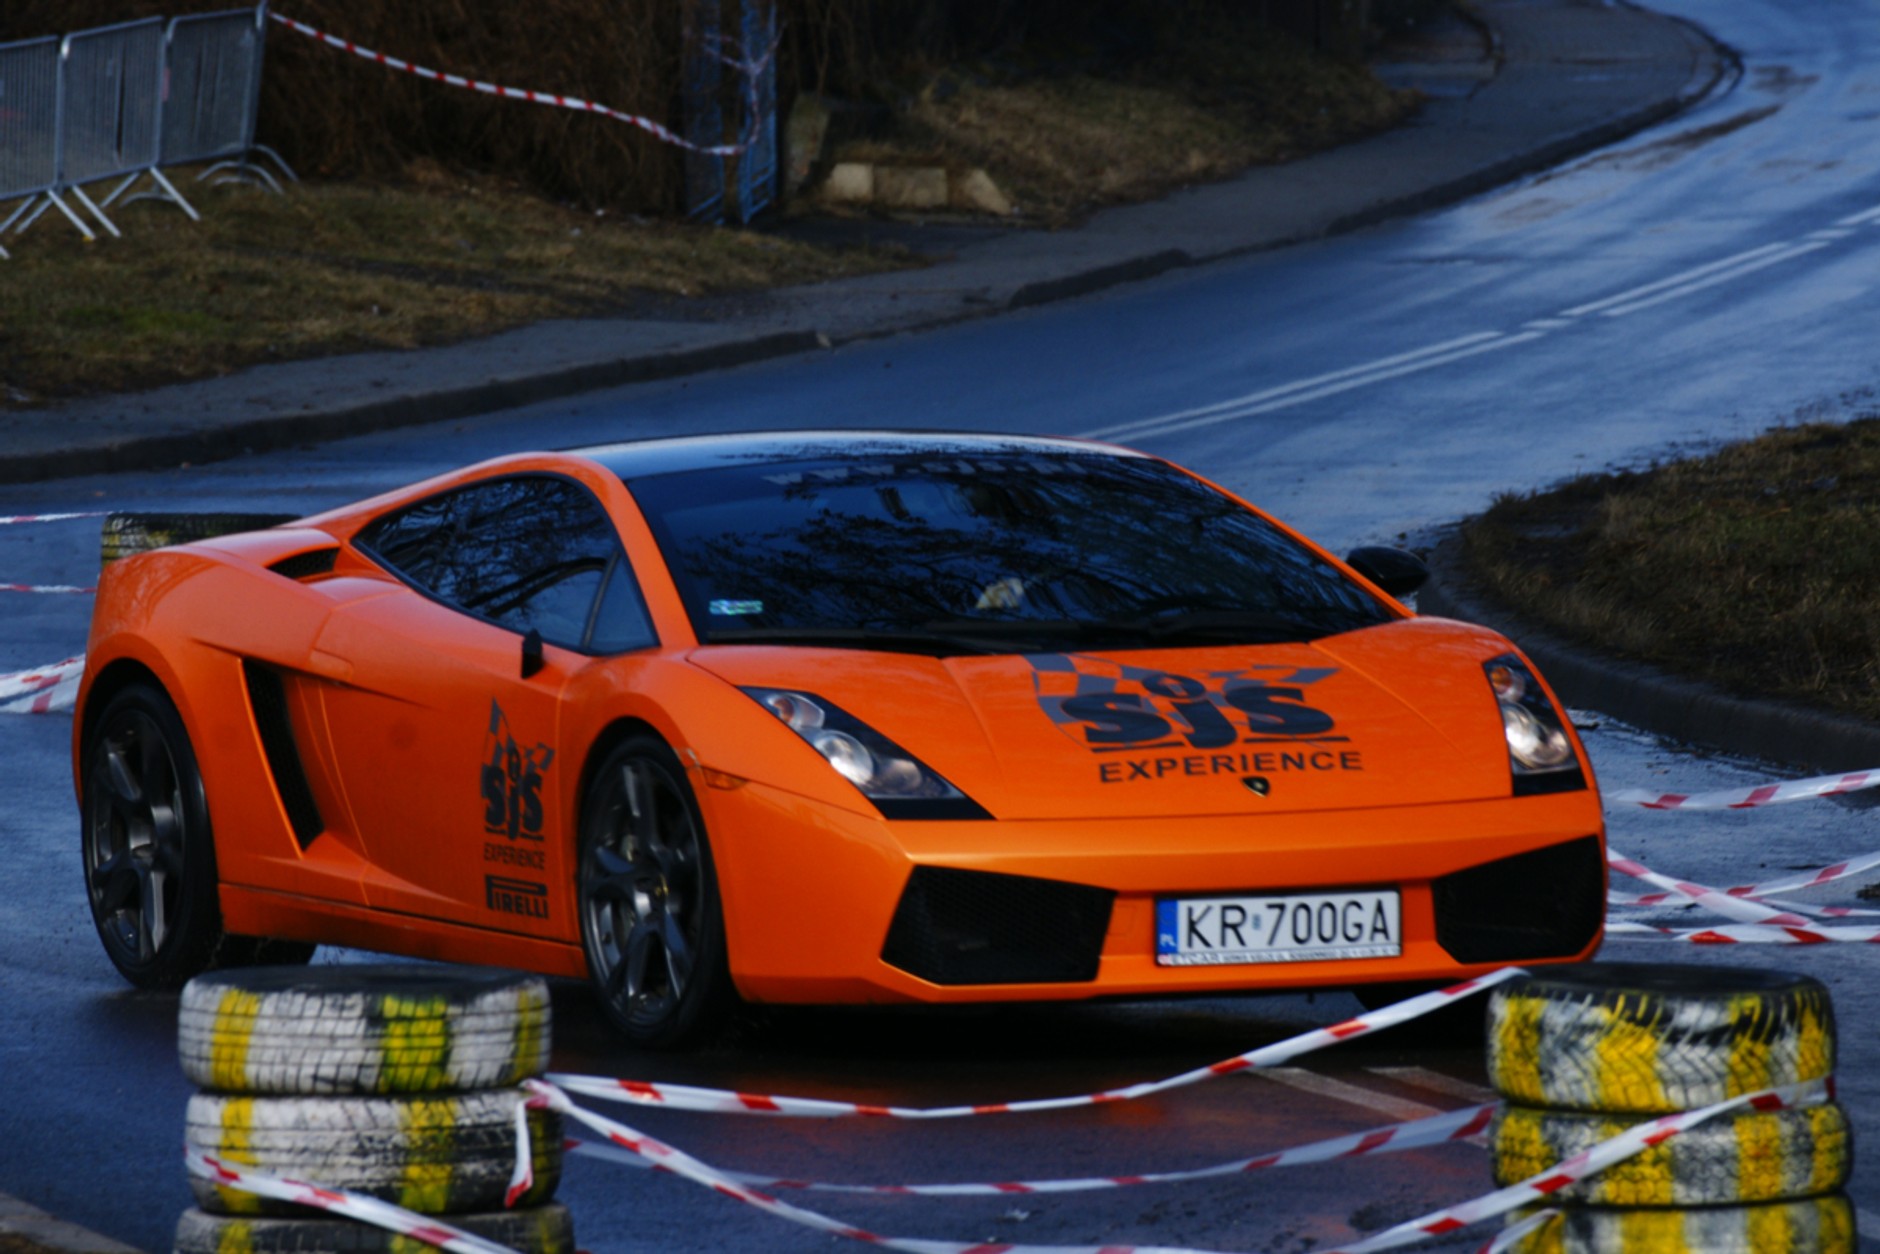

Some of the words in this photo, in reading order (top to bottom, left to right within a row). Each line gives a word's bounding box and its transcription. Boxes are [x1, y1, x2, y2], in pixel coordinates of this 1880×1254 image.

[1099, 751, 1364, 783] EXPERIENCE
[484, 843, 545, 870] EXPERIENCE
[485, 874, 548, 919] PIRELLI
